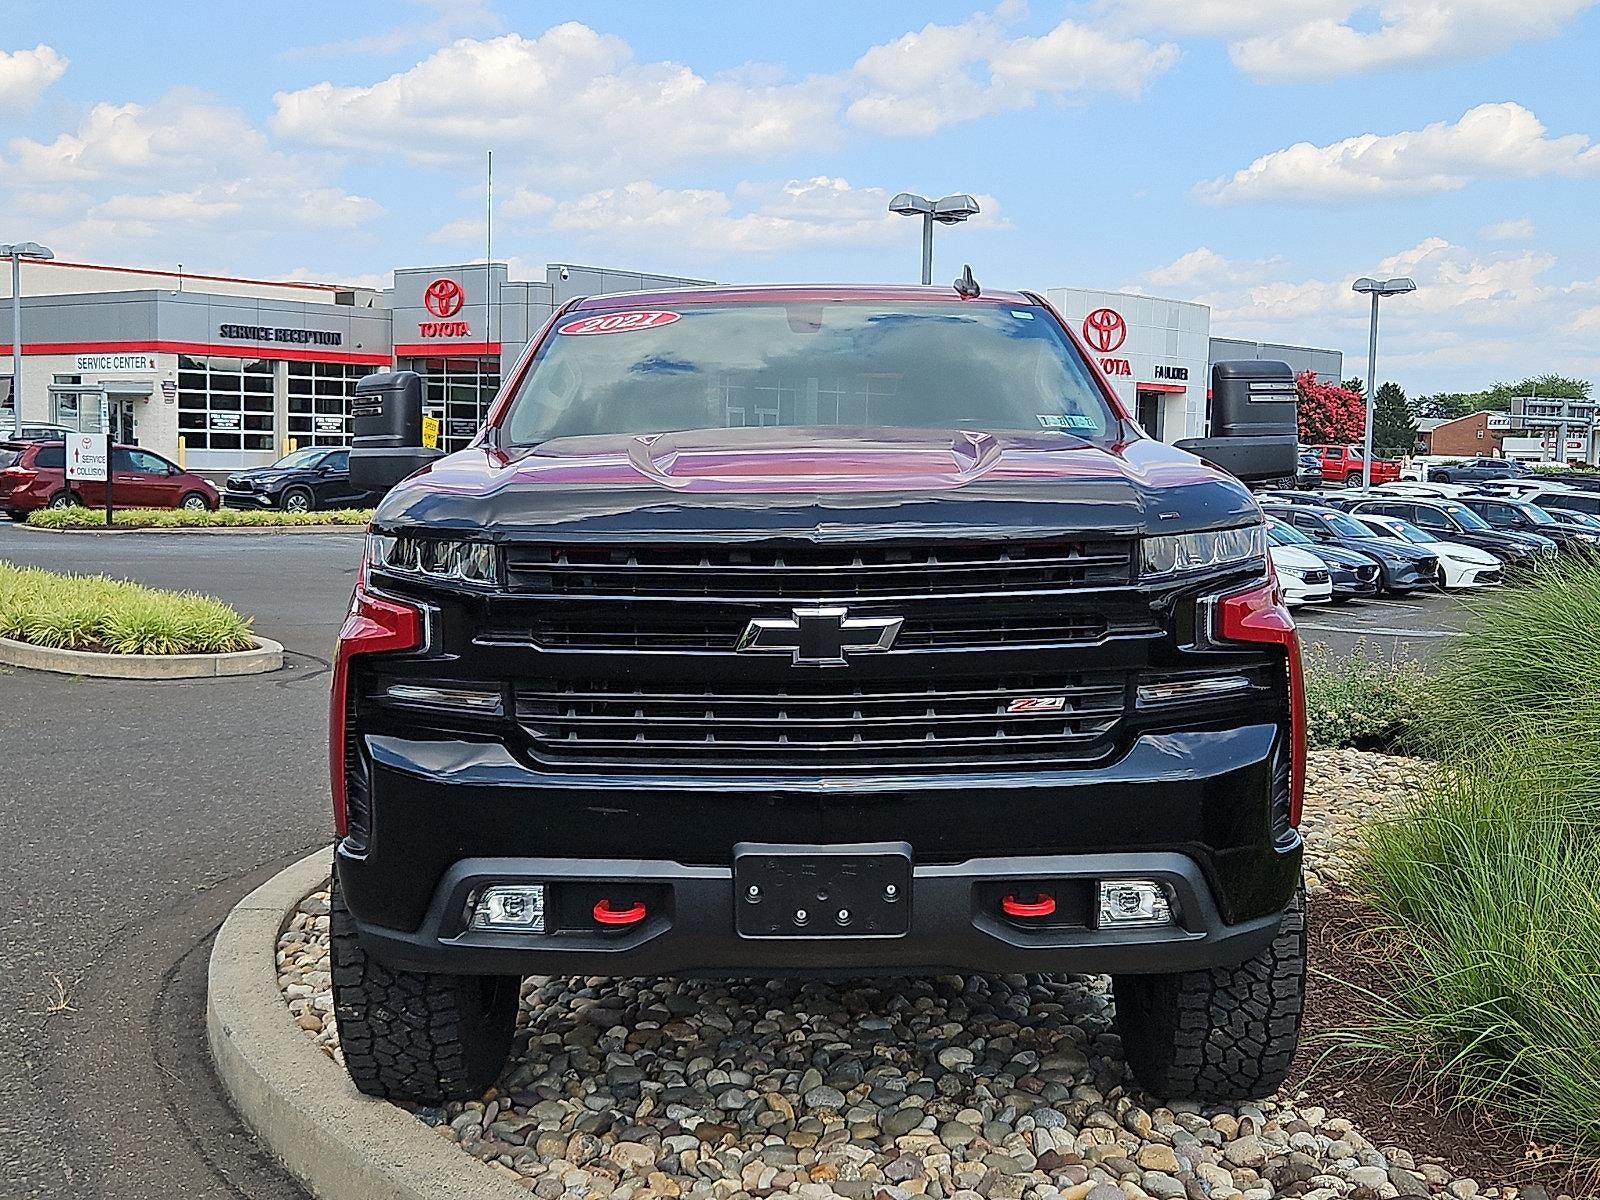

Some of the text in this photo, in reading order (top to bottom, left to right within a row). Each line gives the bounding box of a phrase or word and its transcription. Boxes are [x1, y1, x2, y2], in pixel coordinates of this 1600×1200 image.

[418, 321, 472, 338] TOYOTA
[576, 313, 662, 333] 2021
[219, 324, 342, 345] SERVICE RECEPTION
[77, 355, 147, 370] SERVICE CENTER
[1096, 357, 1132, 376] YOTA
[81, 454, 106, 465] SERVICE
[76, 466, 106, 476] COLLISION
[1007, 697, 1066, 712] Z71
